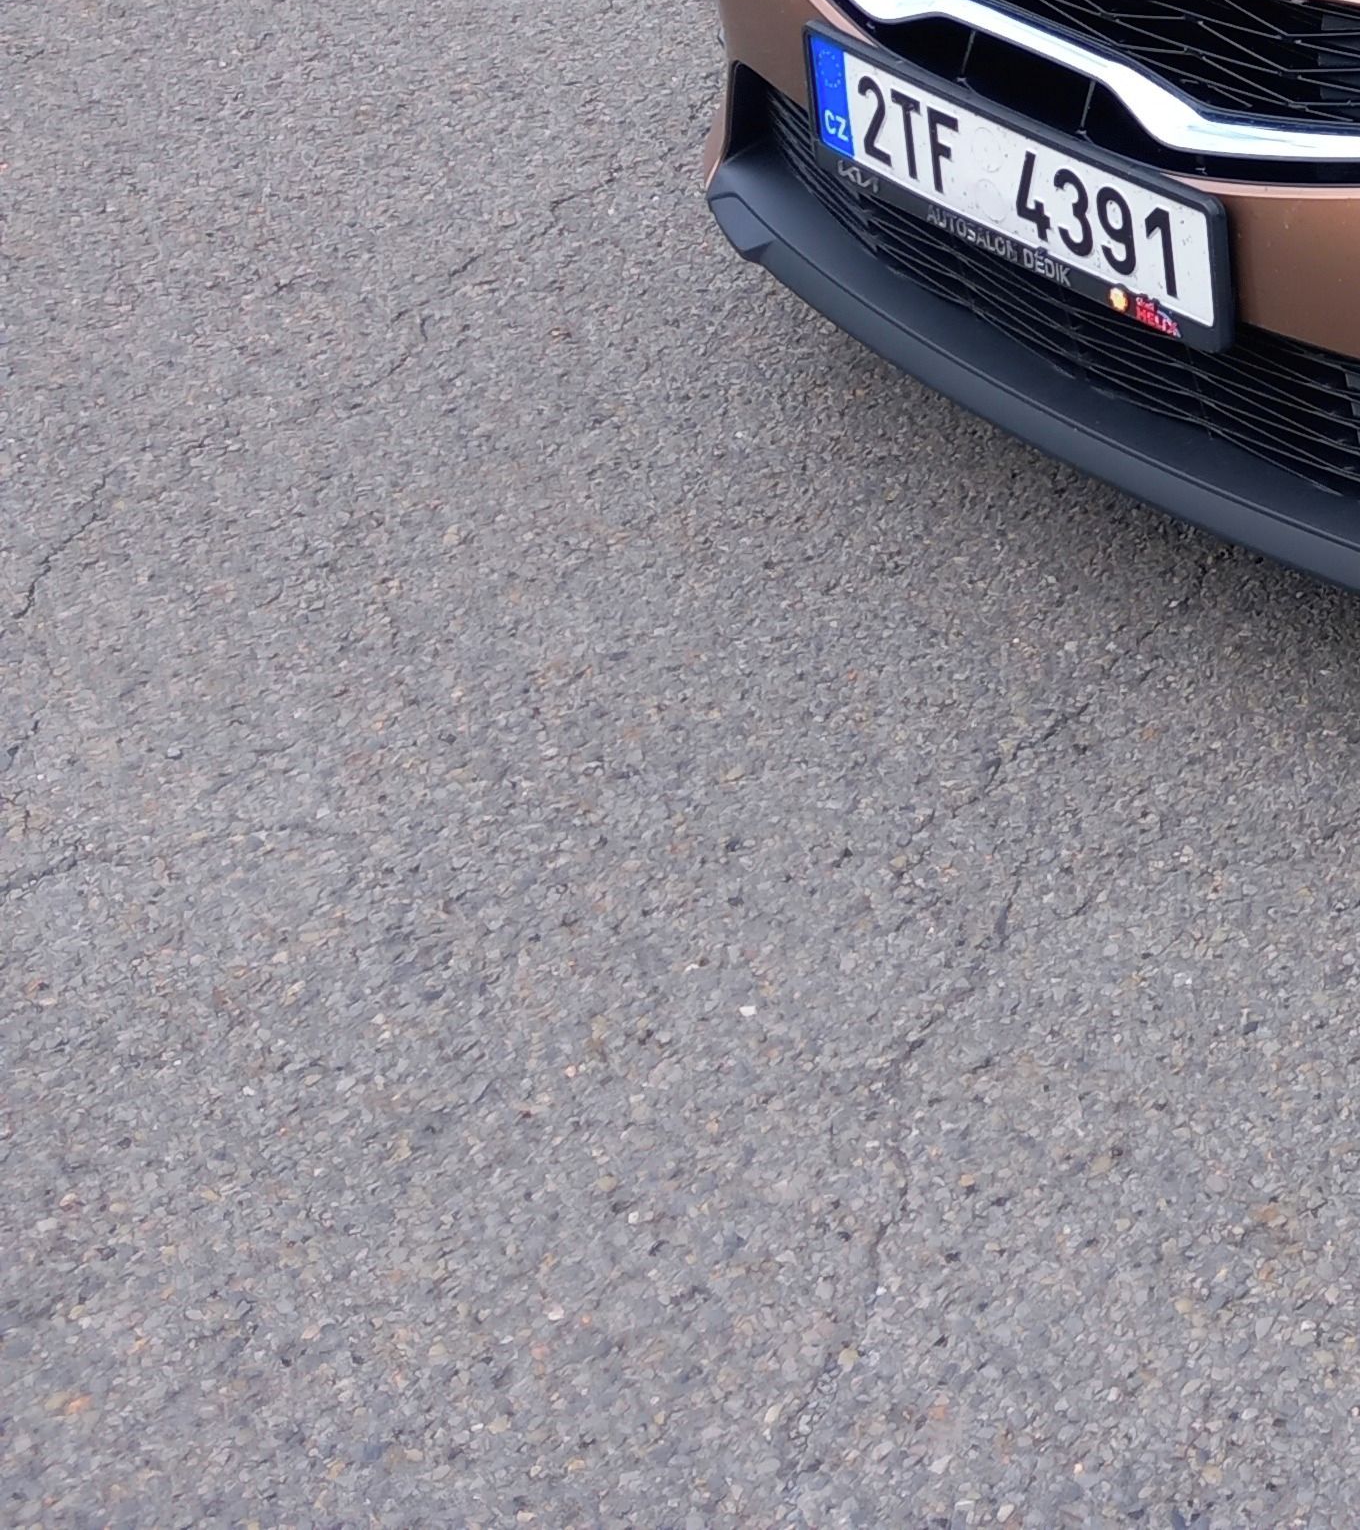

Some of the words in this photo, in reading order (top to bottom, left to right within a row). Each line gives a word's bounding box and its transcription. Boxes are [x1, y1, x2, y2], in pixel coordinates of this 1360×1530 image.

[824, 109, 850, 142] CZ
[857, 75, 959, 195] 2TF
[1016, 150, 1179, 299] 4391
[926, 205, 1018, 263] AUTOSALON
